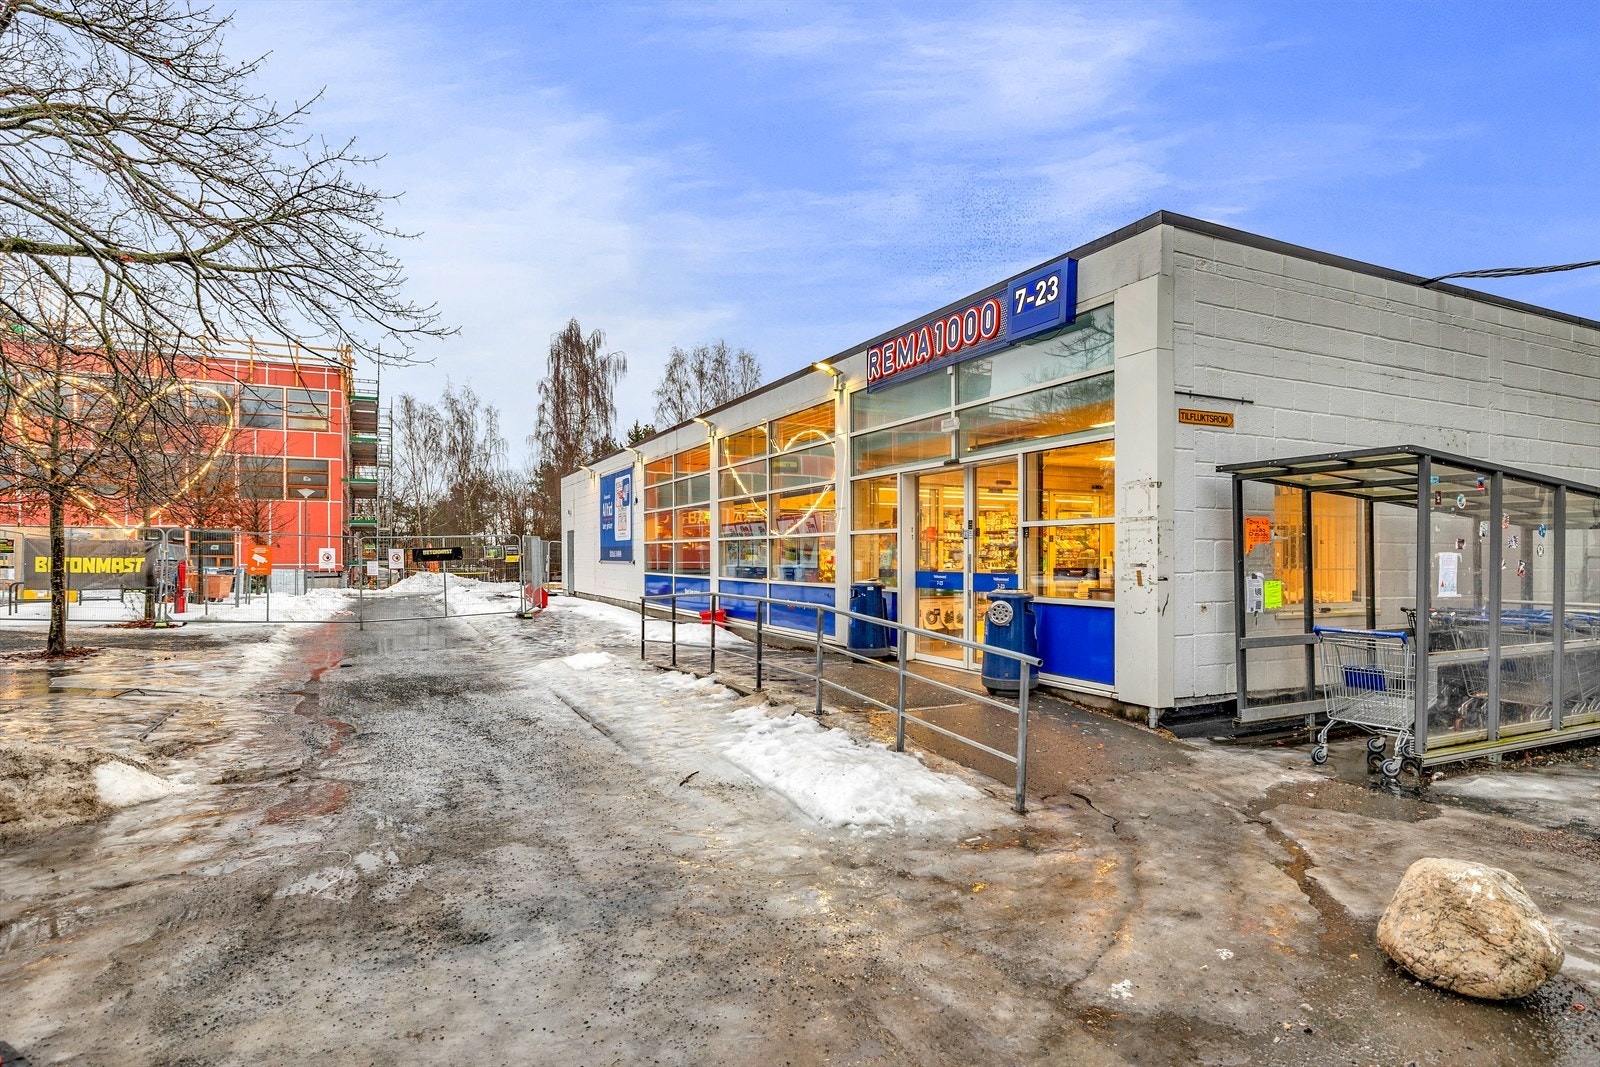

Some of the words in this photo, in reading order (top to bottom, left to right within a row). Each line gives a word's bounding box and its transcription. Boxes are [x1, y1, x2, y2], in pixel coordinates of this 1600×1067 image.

[1014, 275, 1059, 314] 7-23
[1180, 411, 1228, 424] TILFLUKTSROM
[34, 556, 145, 573] BTONMAST
